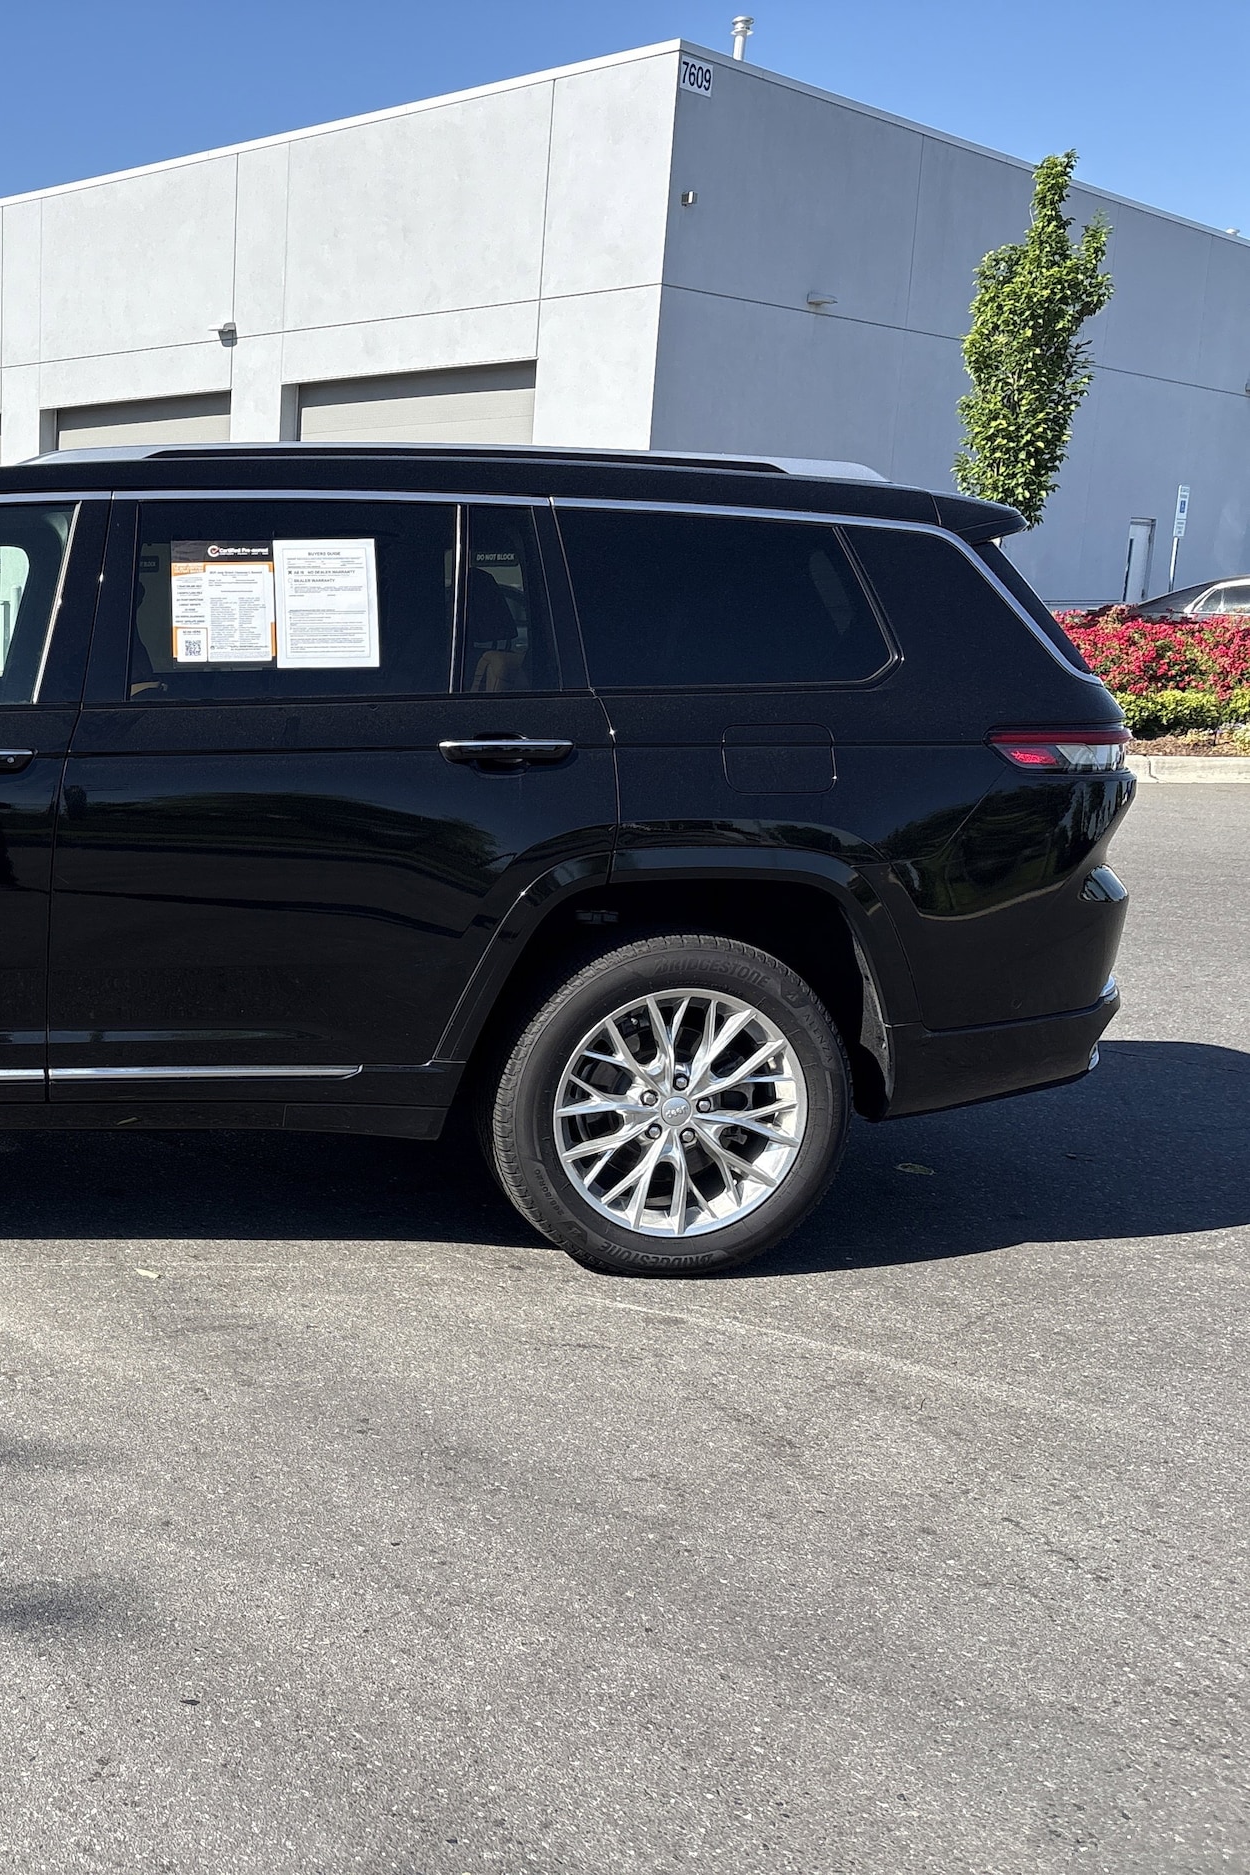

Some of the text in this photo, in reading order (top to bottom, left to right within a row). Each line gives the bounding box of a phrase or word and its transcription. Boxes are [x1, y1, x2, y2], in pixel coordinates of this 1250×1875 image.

[682, 61, 712, 91] 7609
[653, 955, 771, 989] BRIDGESTONE
[802, 1013, 834, 1064] ALENZA
[596, 1241, 714, 1268] BRIDGESTONE
